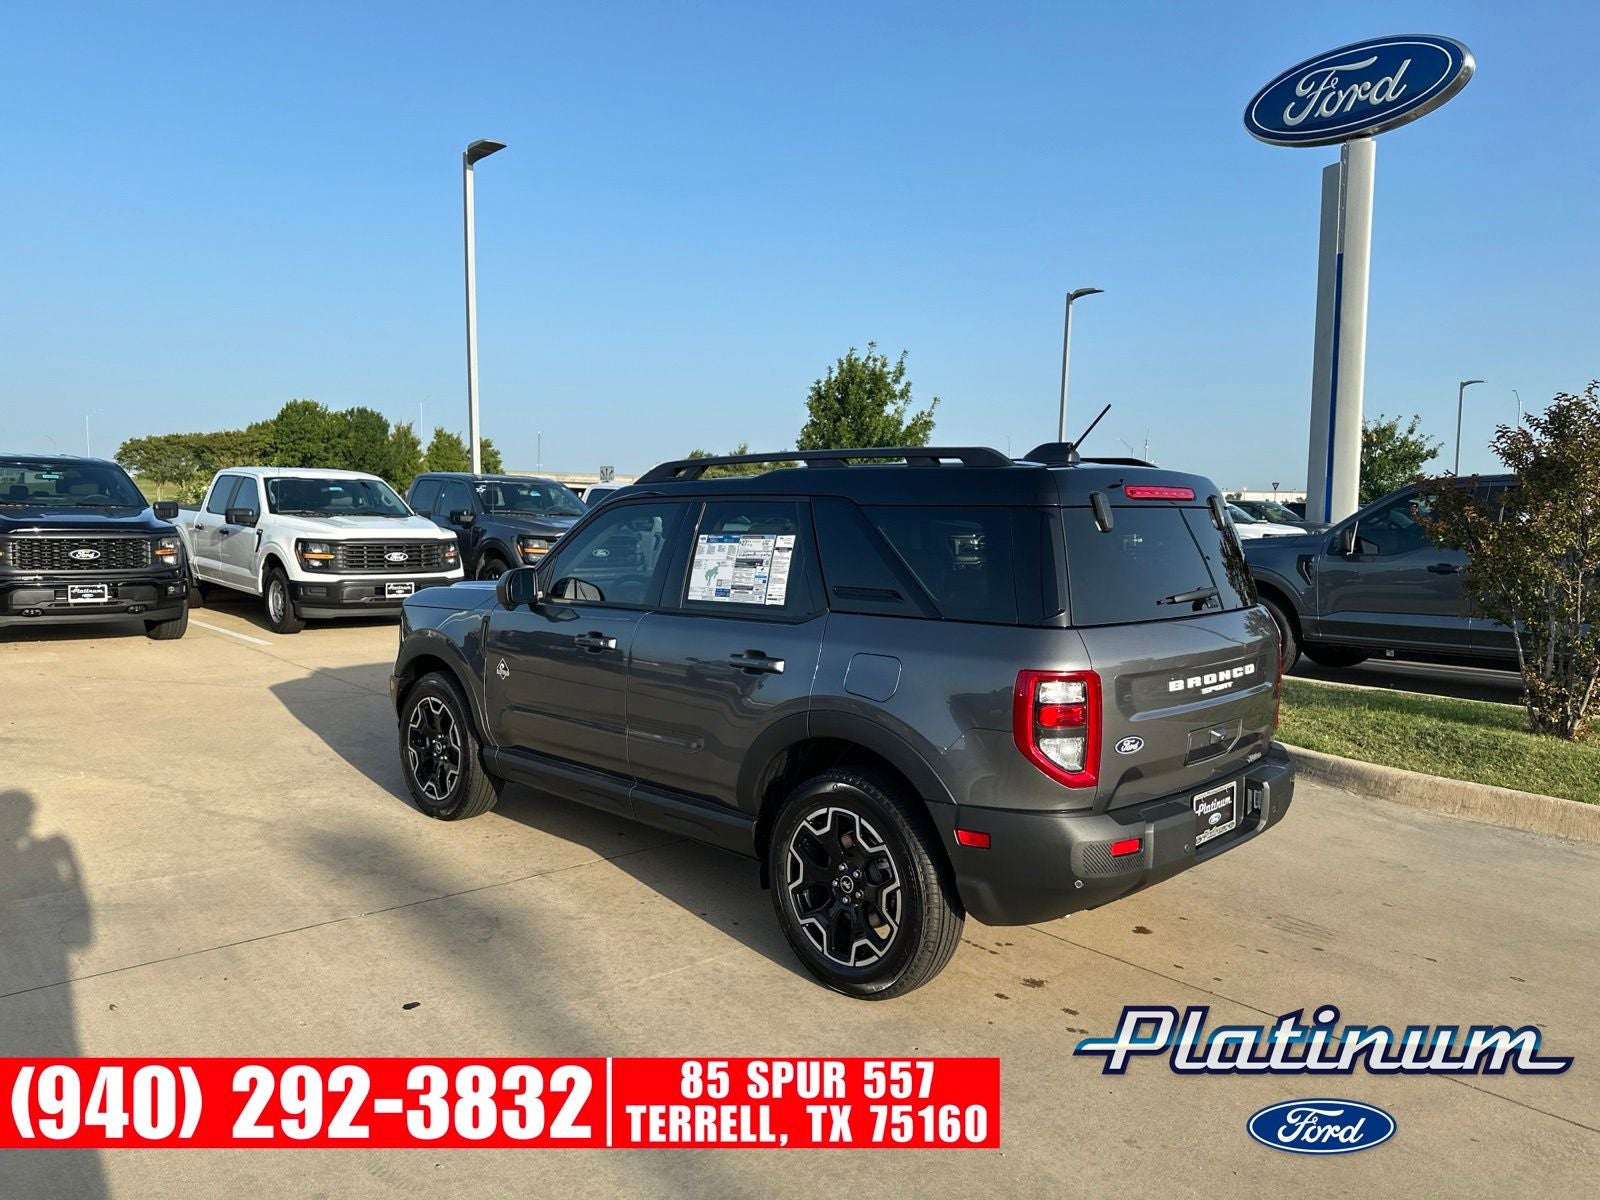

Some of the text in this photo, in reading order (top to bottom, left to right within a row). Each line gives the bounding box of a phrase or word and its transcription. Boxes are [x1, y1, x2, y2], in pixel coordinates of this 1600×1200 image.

[1283, 56, 1412, 126] Ford
[1168, 663, 1256, 692] BRONCO
[1120, 739, 1140, 752] Ford
[1195, 796, 1232, 816] Platinum
